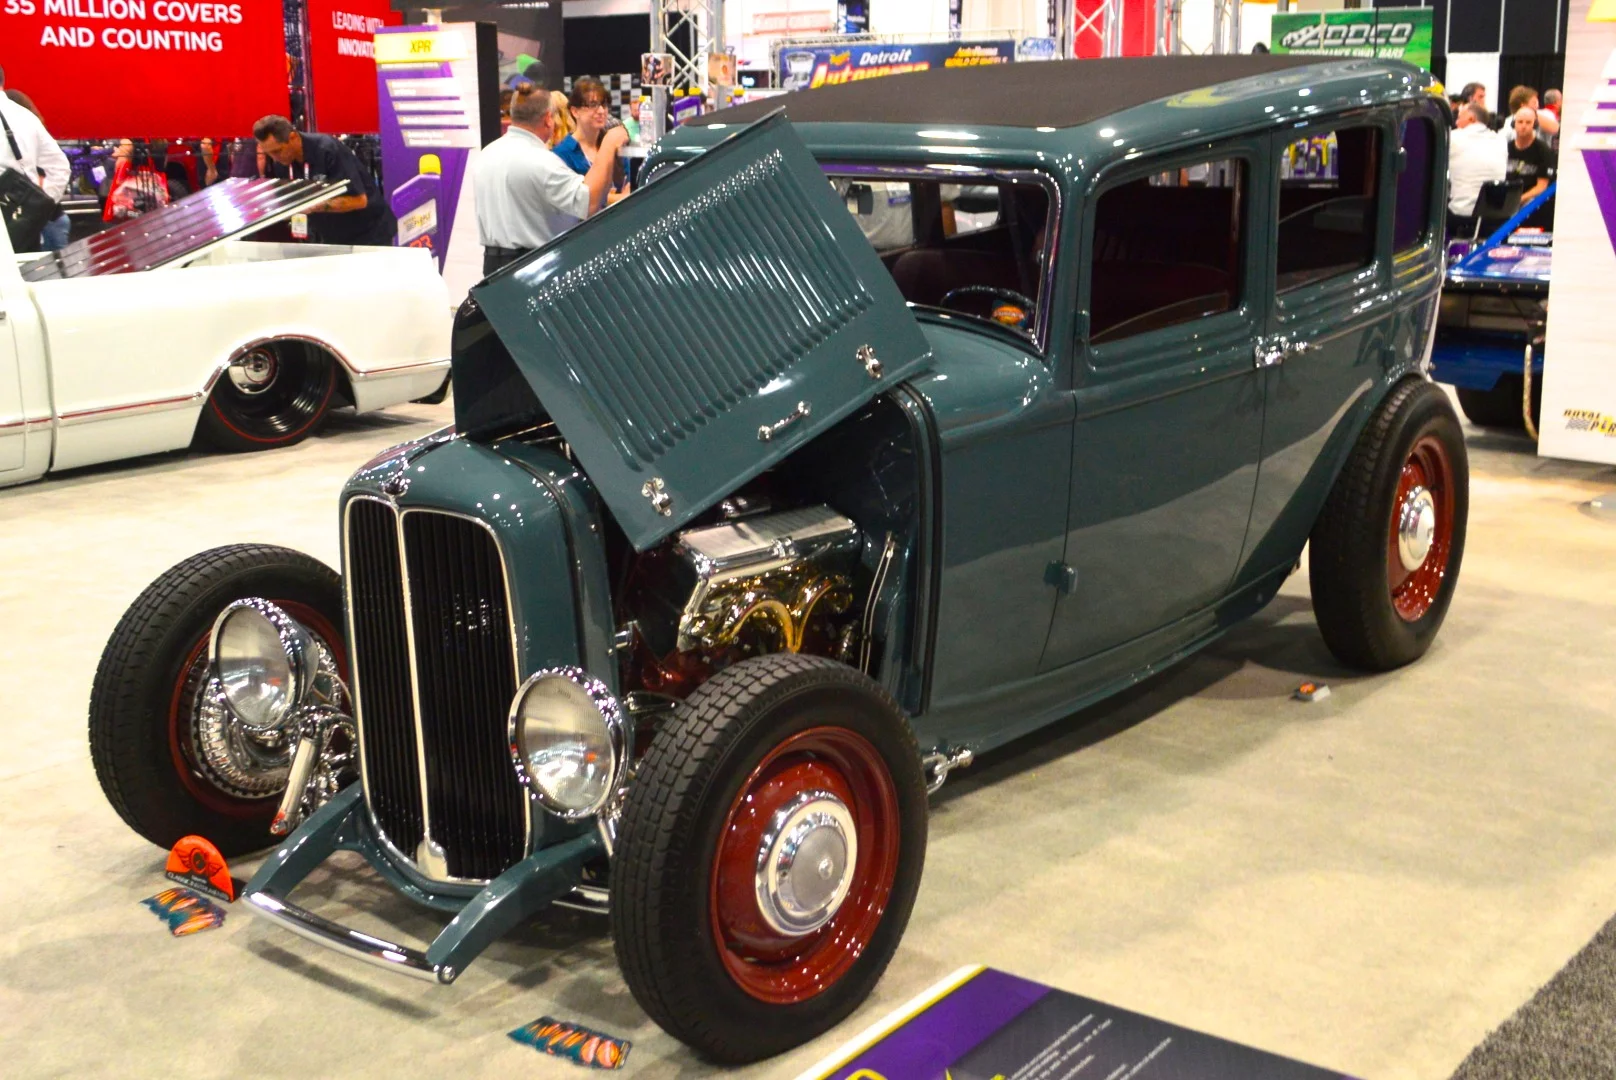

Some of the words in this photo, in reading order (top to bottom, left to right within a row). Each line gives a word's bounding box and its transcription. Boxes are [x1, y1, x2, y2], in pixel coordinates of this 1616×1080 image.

[4, 0, 36, 15] 35
[44, 0, 147, 20] MILLION
[153, 1, 243, 24] COVERS
[332, 11, 366, 33] LEADING
[40, 26, 95, 47] AND
[101, 28, 223, 52] COUNTING
[859, 49, 912, 66] Detroit
